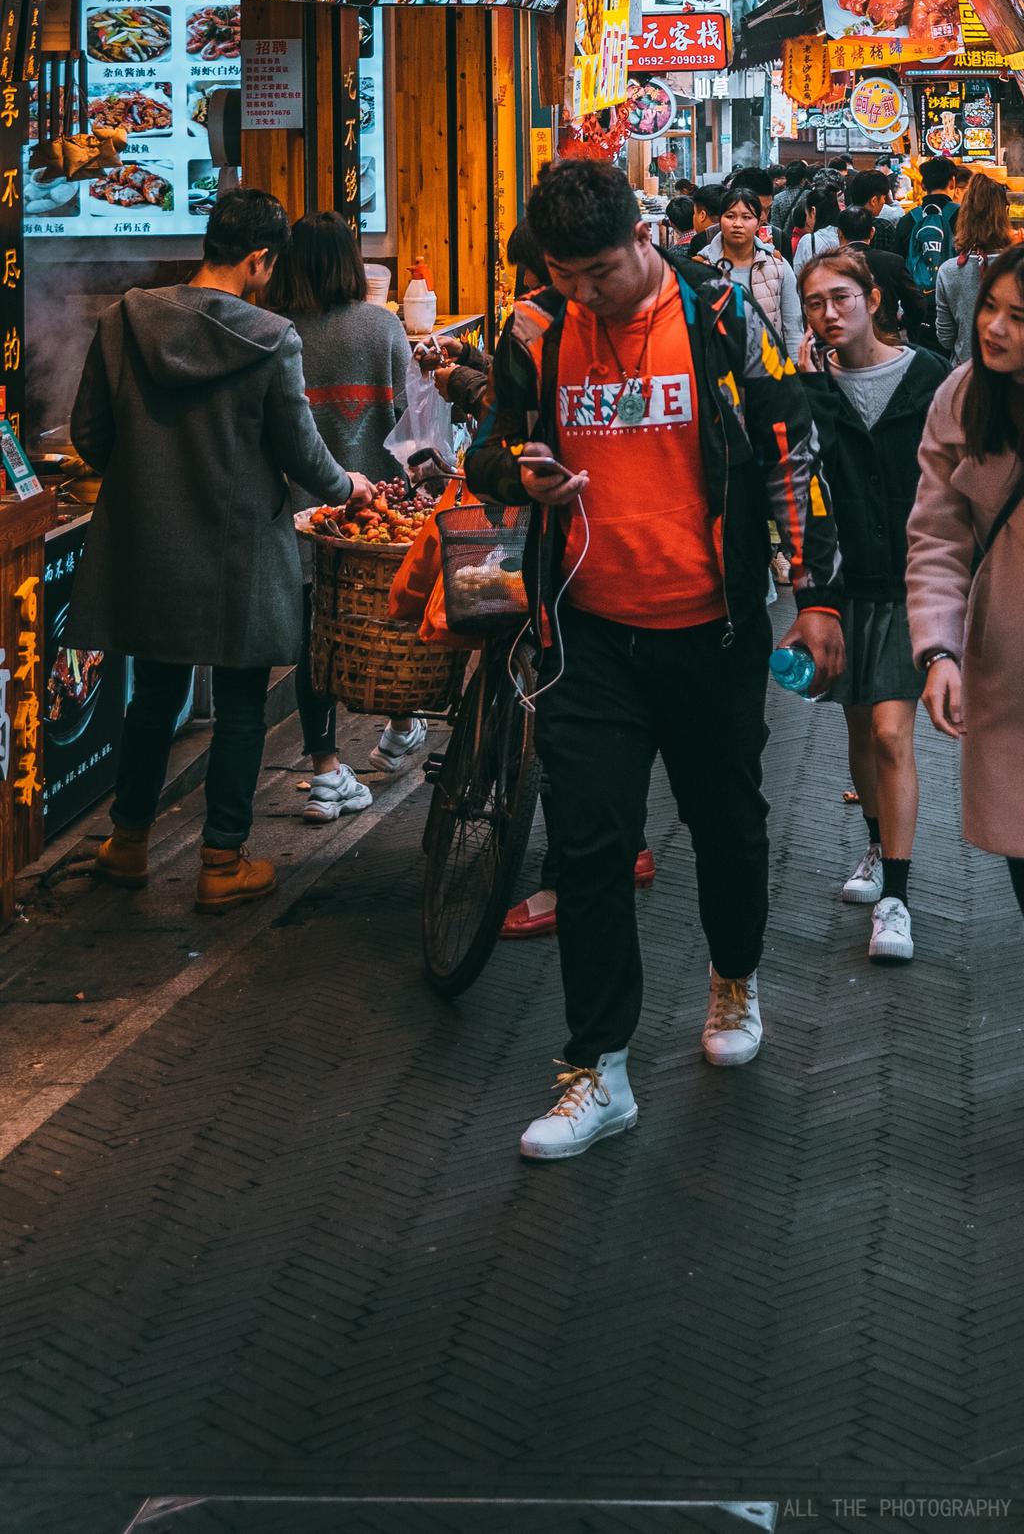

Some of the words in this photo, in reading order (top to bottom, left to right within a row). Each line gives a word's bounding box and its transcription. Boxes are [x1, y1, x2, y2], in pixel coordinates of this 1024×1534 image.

[255, 40, 288, 55] 招聘
[638, 55, 716, 66] 0592-2090338
[854, 95, 897, 123] 蚵仔煎
[928, 96, 961, 109] 沙茶面
[567, 382, 684, 423] FIE
